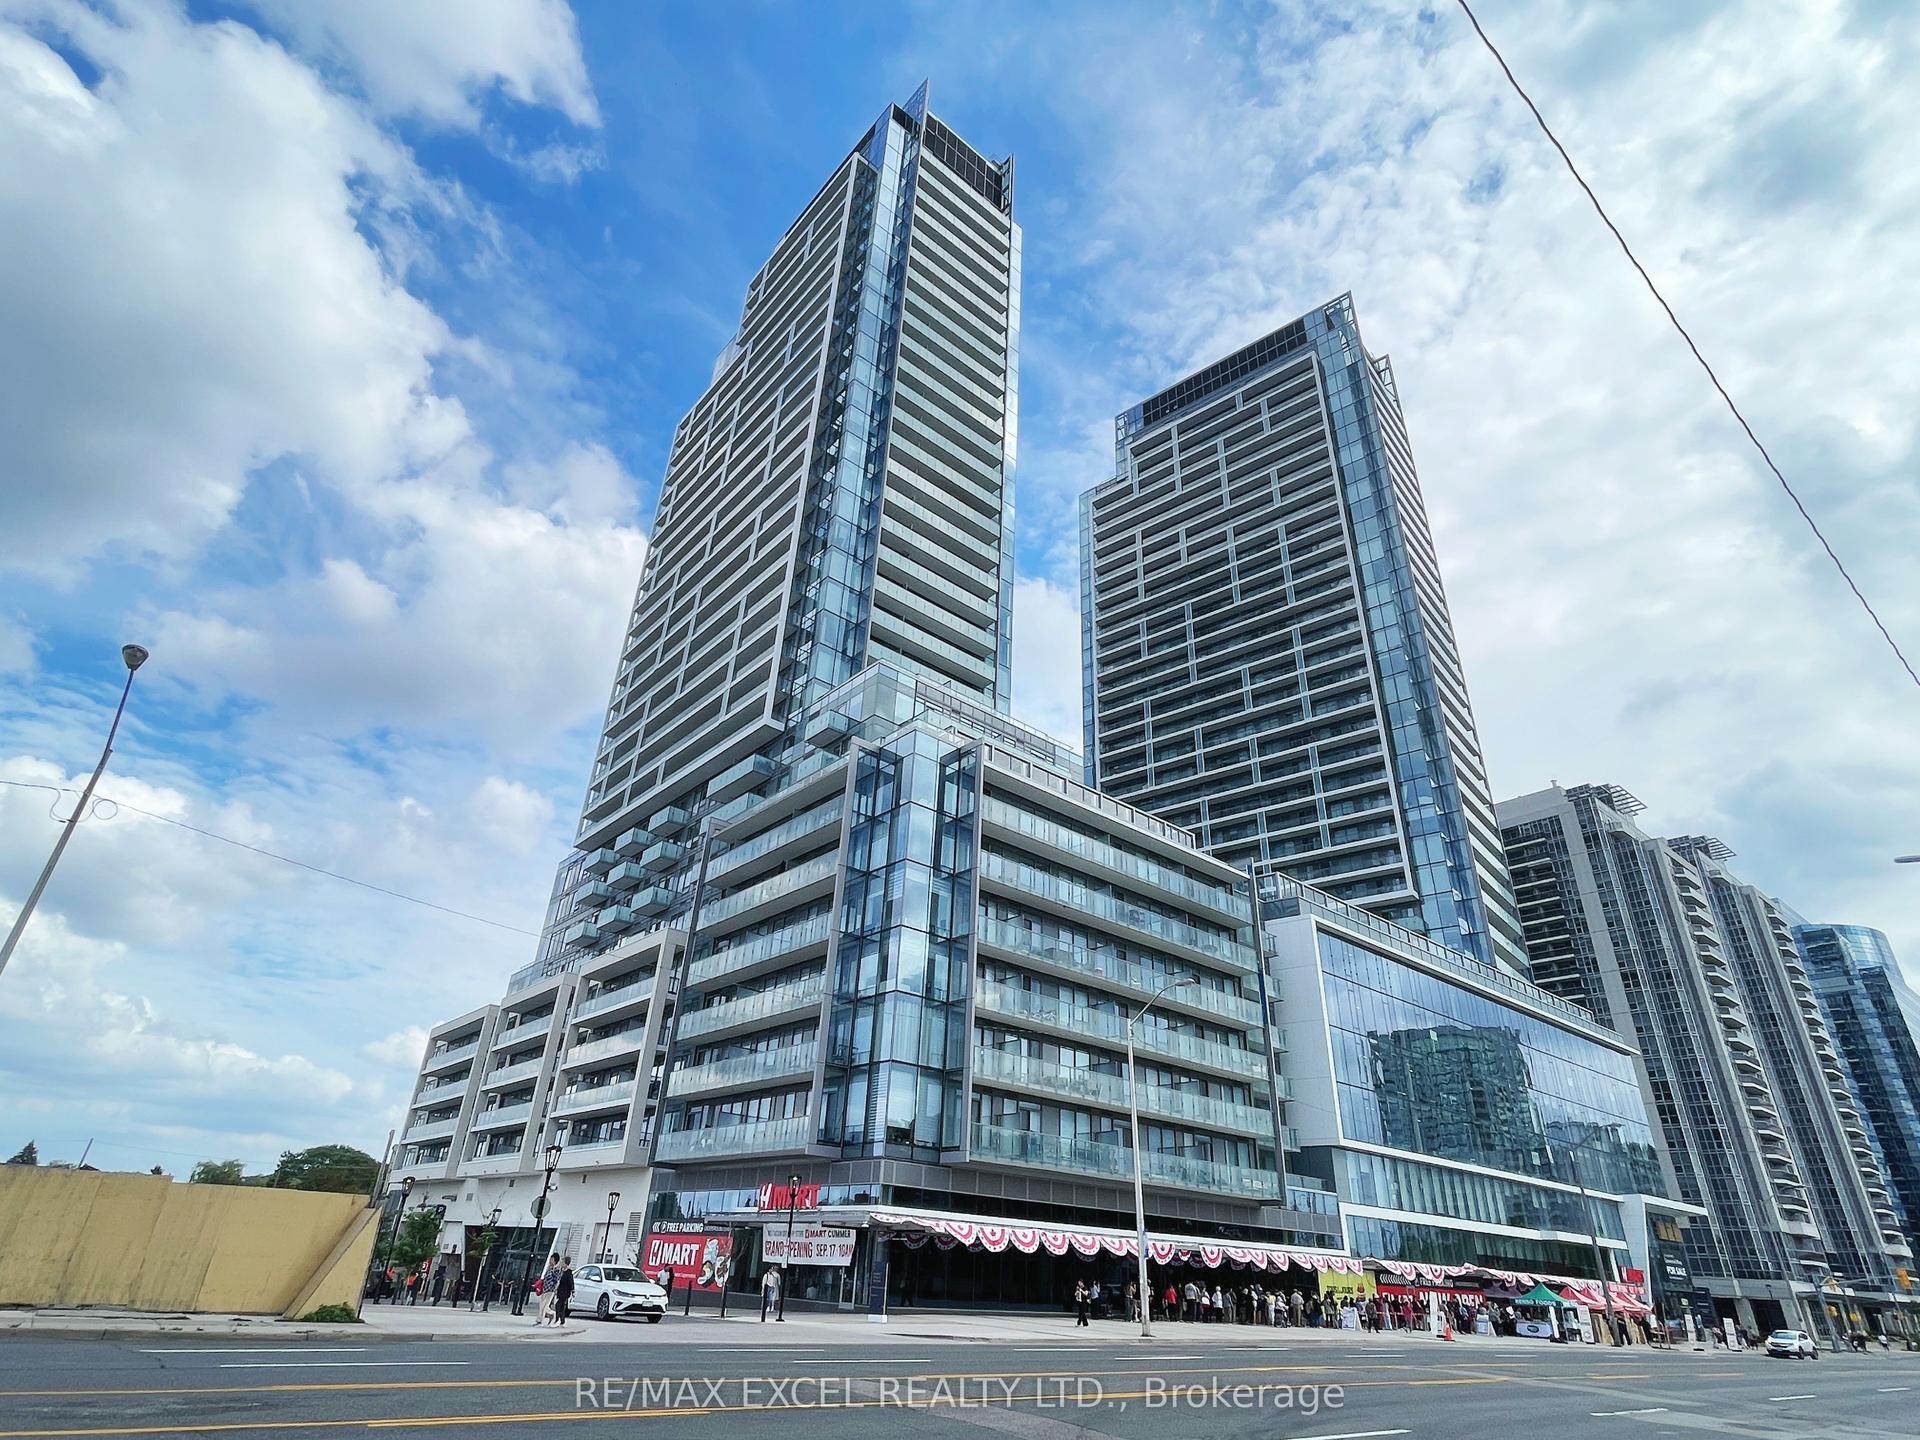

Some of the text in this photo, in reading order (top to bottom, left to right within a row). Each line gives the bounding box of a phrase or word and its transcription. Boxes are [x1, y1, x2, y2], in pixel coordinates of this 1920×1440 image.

[667, 1222, 680, 1232] FREE
[679, 1222, 704, 1233] PARKING
[810, 1230, 827, 1238] MART
[661, 1243, 700, 1266] MART
[784, 1242, 813, 1258] PENING
